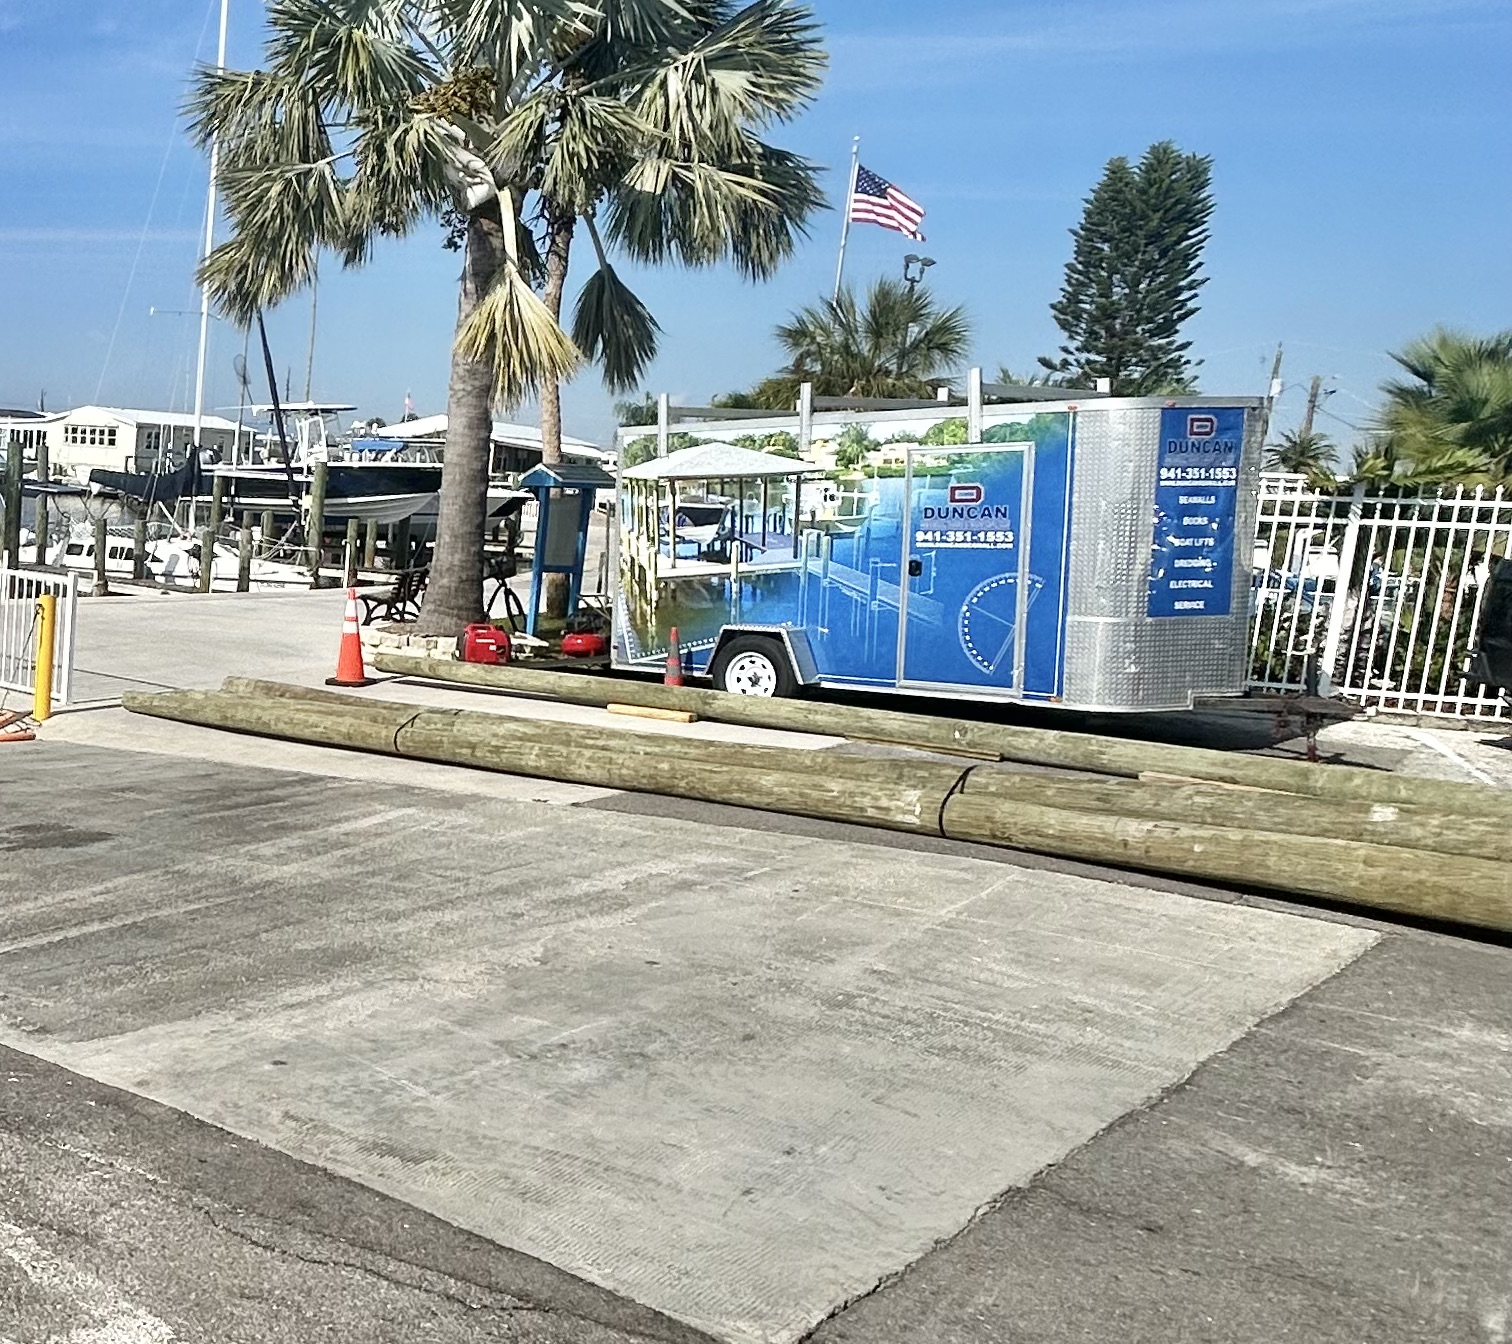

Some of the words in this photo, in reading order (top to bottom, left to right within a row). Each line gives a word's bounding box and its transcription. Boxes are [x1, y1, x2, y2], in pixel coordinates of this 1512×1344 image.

[1168, 441, 1234, 454] DUNCAN
[1160, 467, 1237, 480] 941-351-1553
[923, 506, 1008, 519] DUNCAN
[916, 531, 1014, 542] 941-351-1553
[1194, 538, 1215, 546] LIFTS
[1169, 580, 1214, 589] ELECTRICAL
